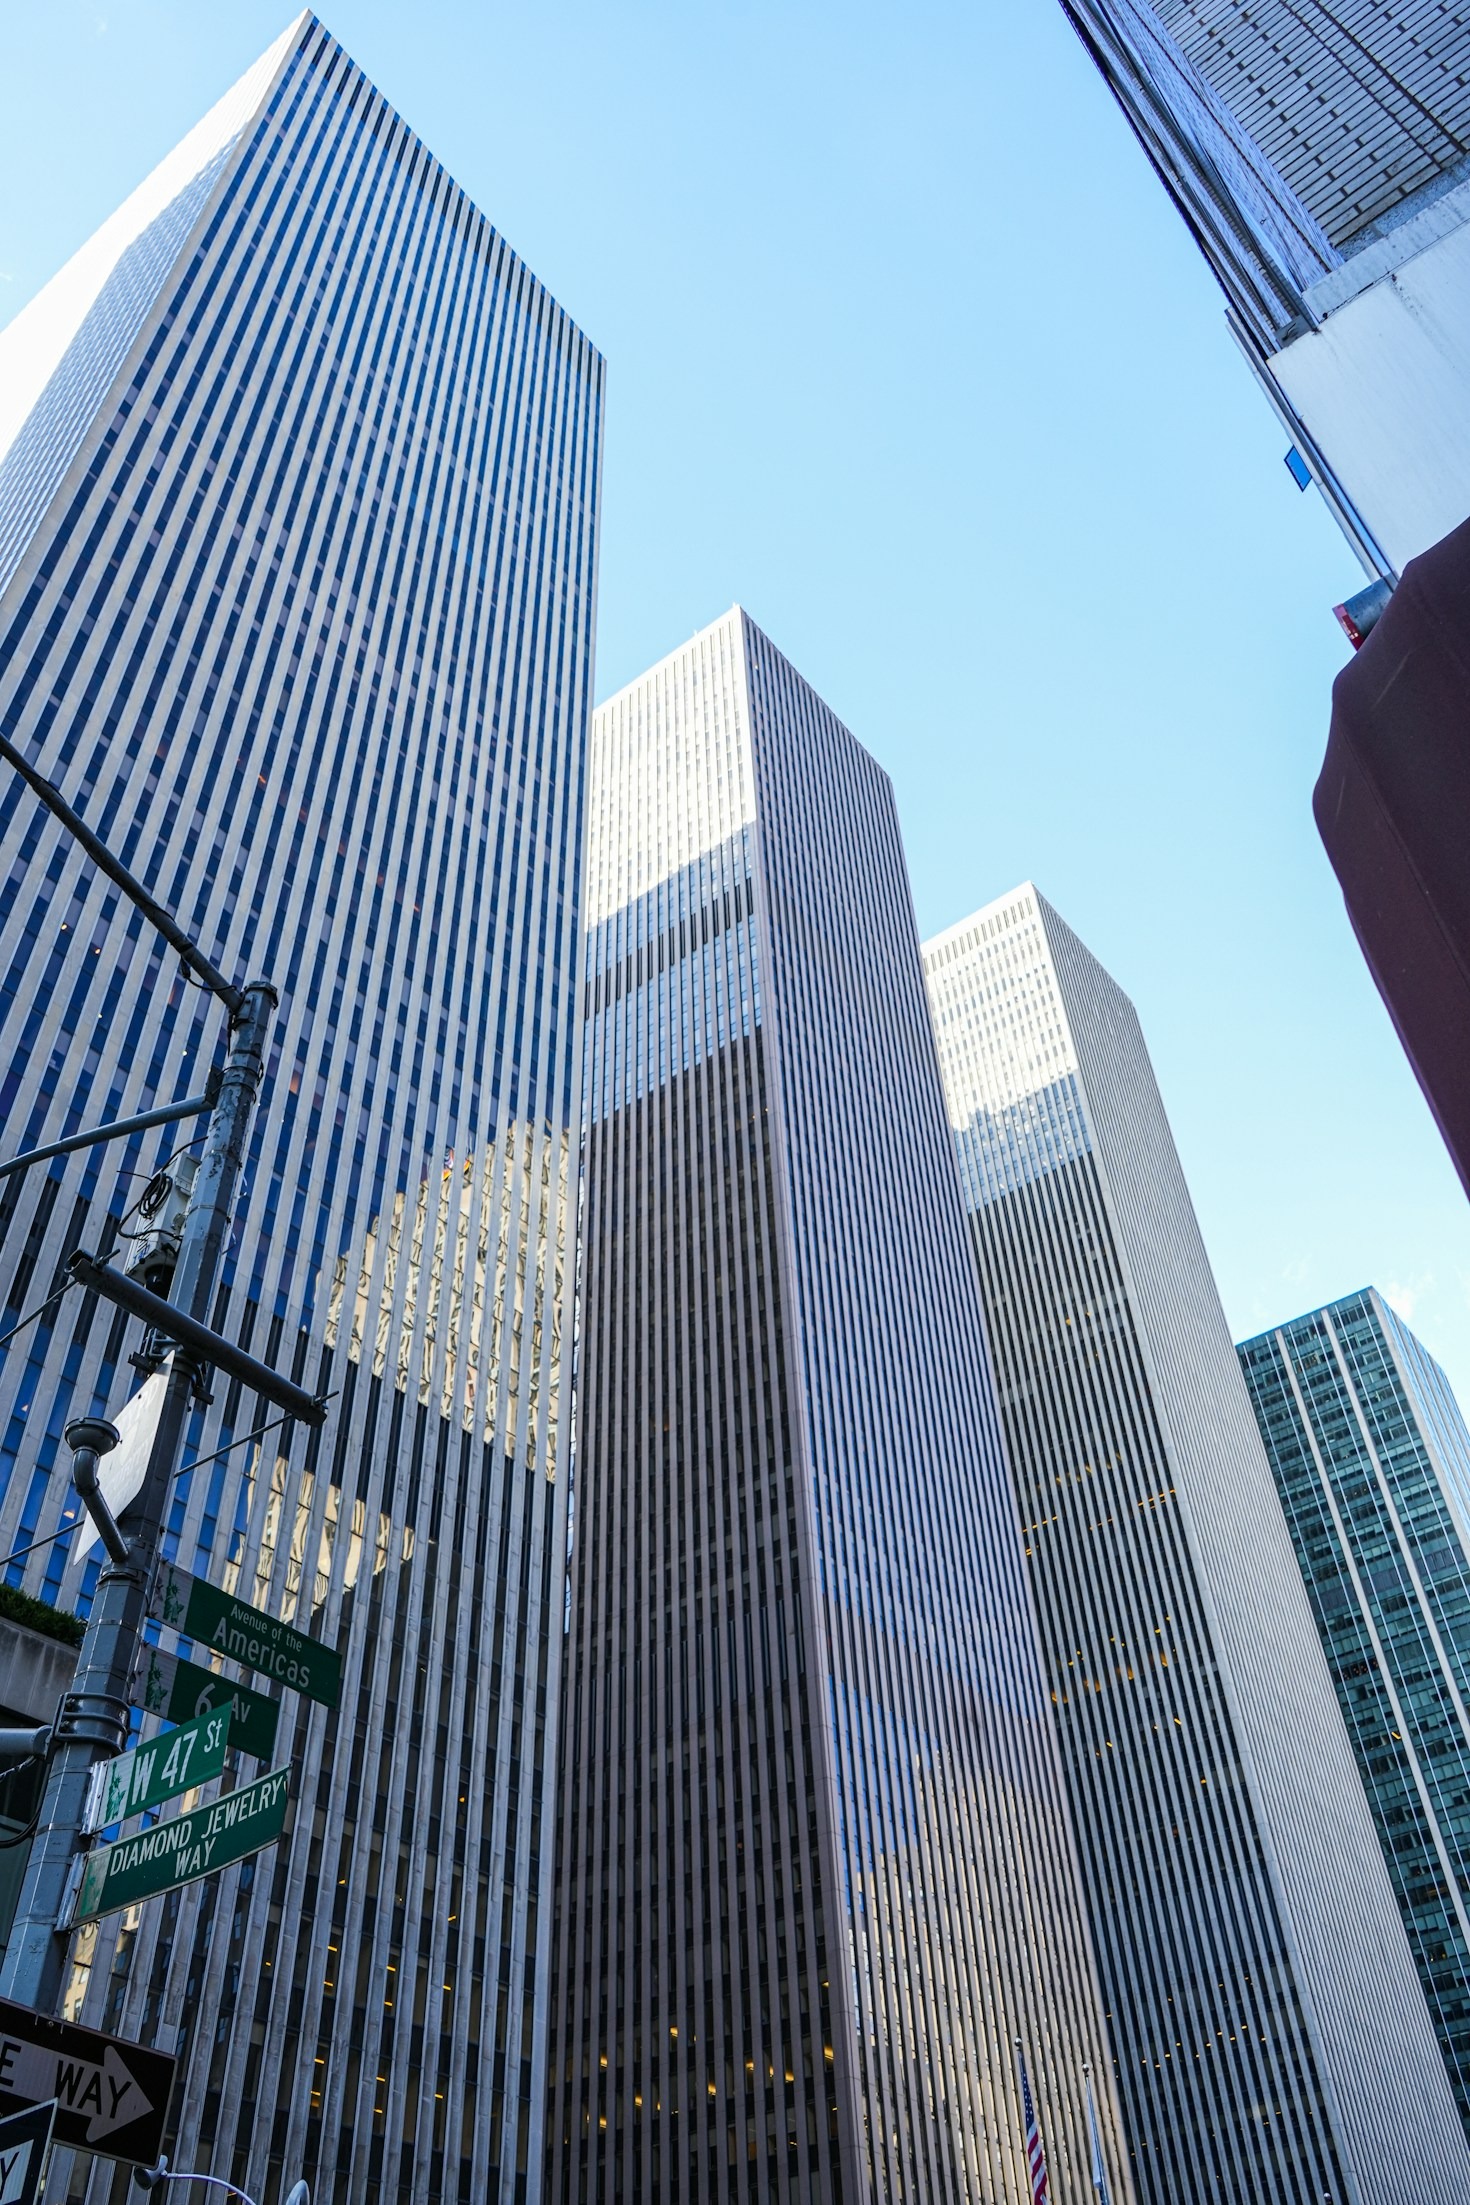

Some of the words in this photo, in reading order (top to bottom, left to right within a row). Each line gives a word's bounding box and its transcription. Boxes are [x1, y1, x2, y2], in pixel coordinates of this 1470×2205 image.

[212, 1616, 310, 1688] Americas
[231, 1604, 268, 1634] Avenue
[271, 1628, 282, 1641] of
[286, 1633, 302, 1652] the
[194, 1682, 216, 1719] 6
[231, 1692, 251, 1723] Av
[131, 1748, 158, 1806] W
[161, 1728, 199, 1789] 47
[203, 1717, 223, 1753] St
[110, 1820, 193, 1877] DIAMOND
[201, 1775, 283, 1839] JEWELRY
[174, 1837, 217, 1879] WAY
[54, 2059, 132, 2120] WAY
